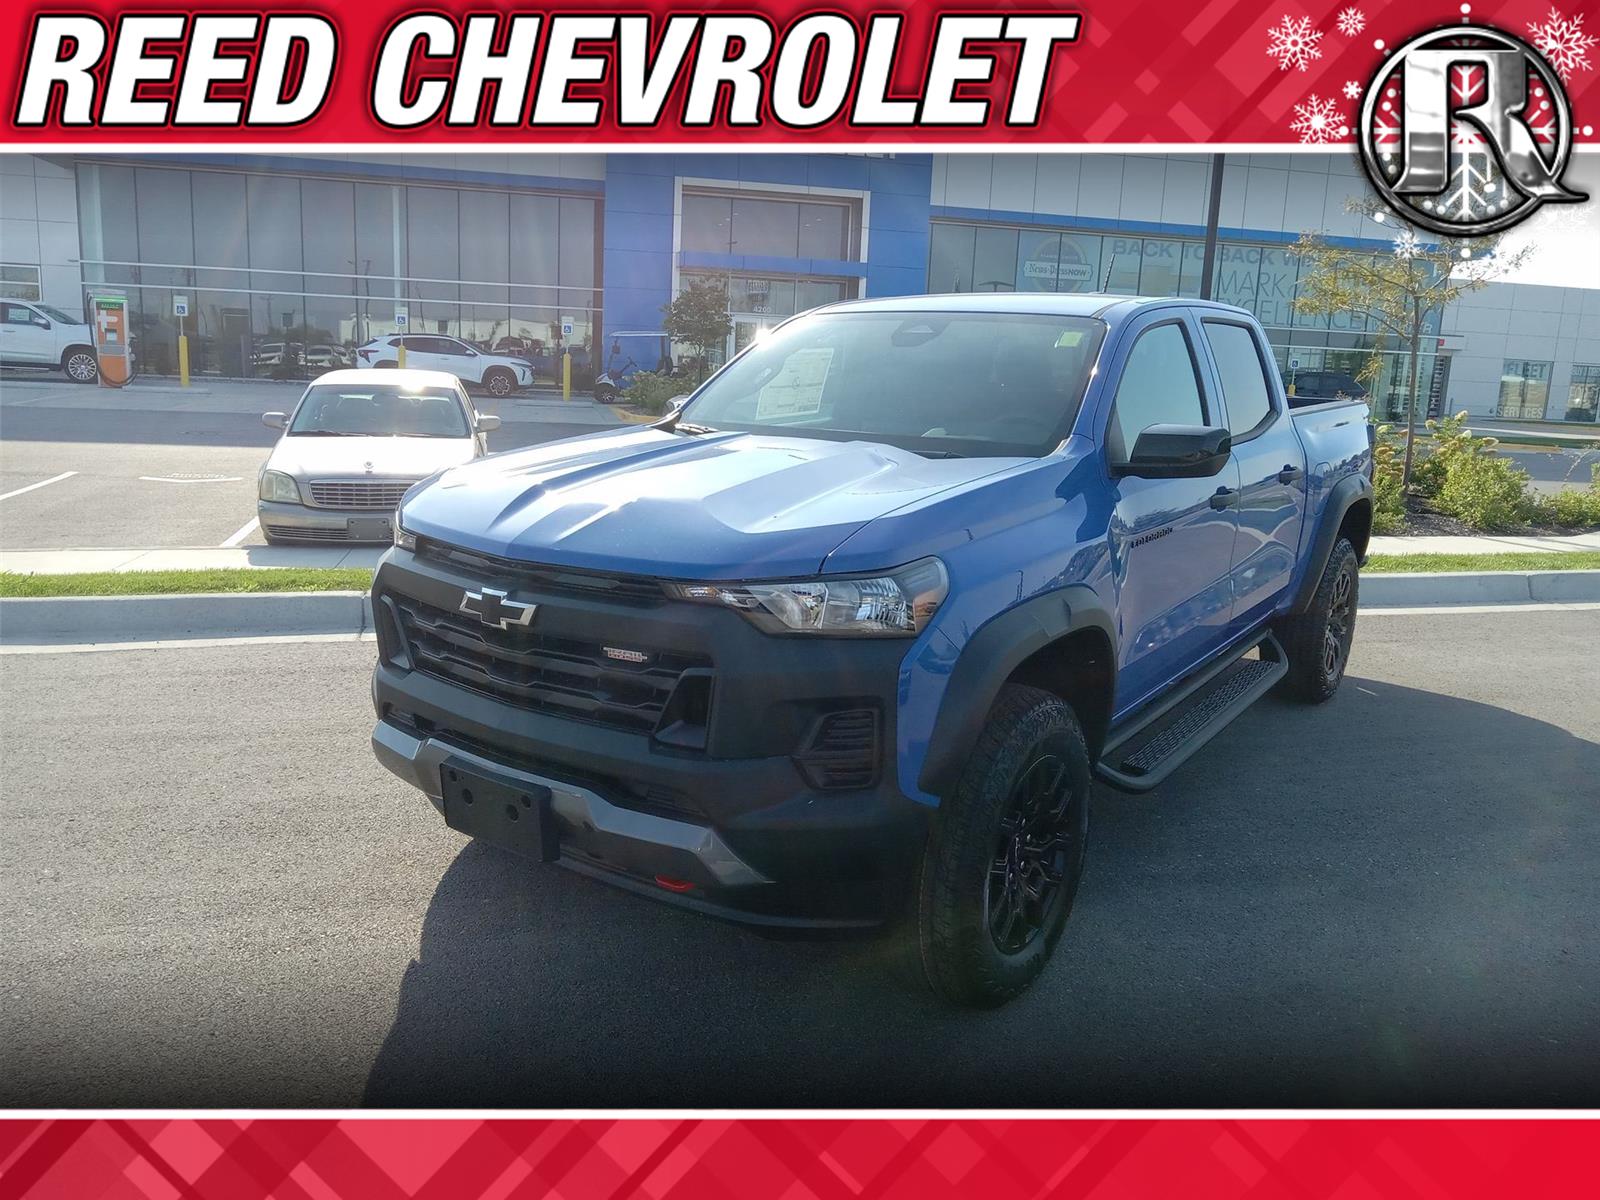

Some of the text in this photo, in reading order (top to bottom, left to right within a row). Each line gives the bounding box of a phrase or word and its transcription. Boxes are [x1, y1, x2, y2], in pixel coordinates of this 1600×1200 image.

[1112, 239, 1174, 259] BACK
[1217, 246, 1275, 267] BACK
[1216, 270, 1287, 298] MARK
[1503, 361, 1546, 378] FLEET
